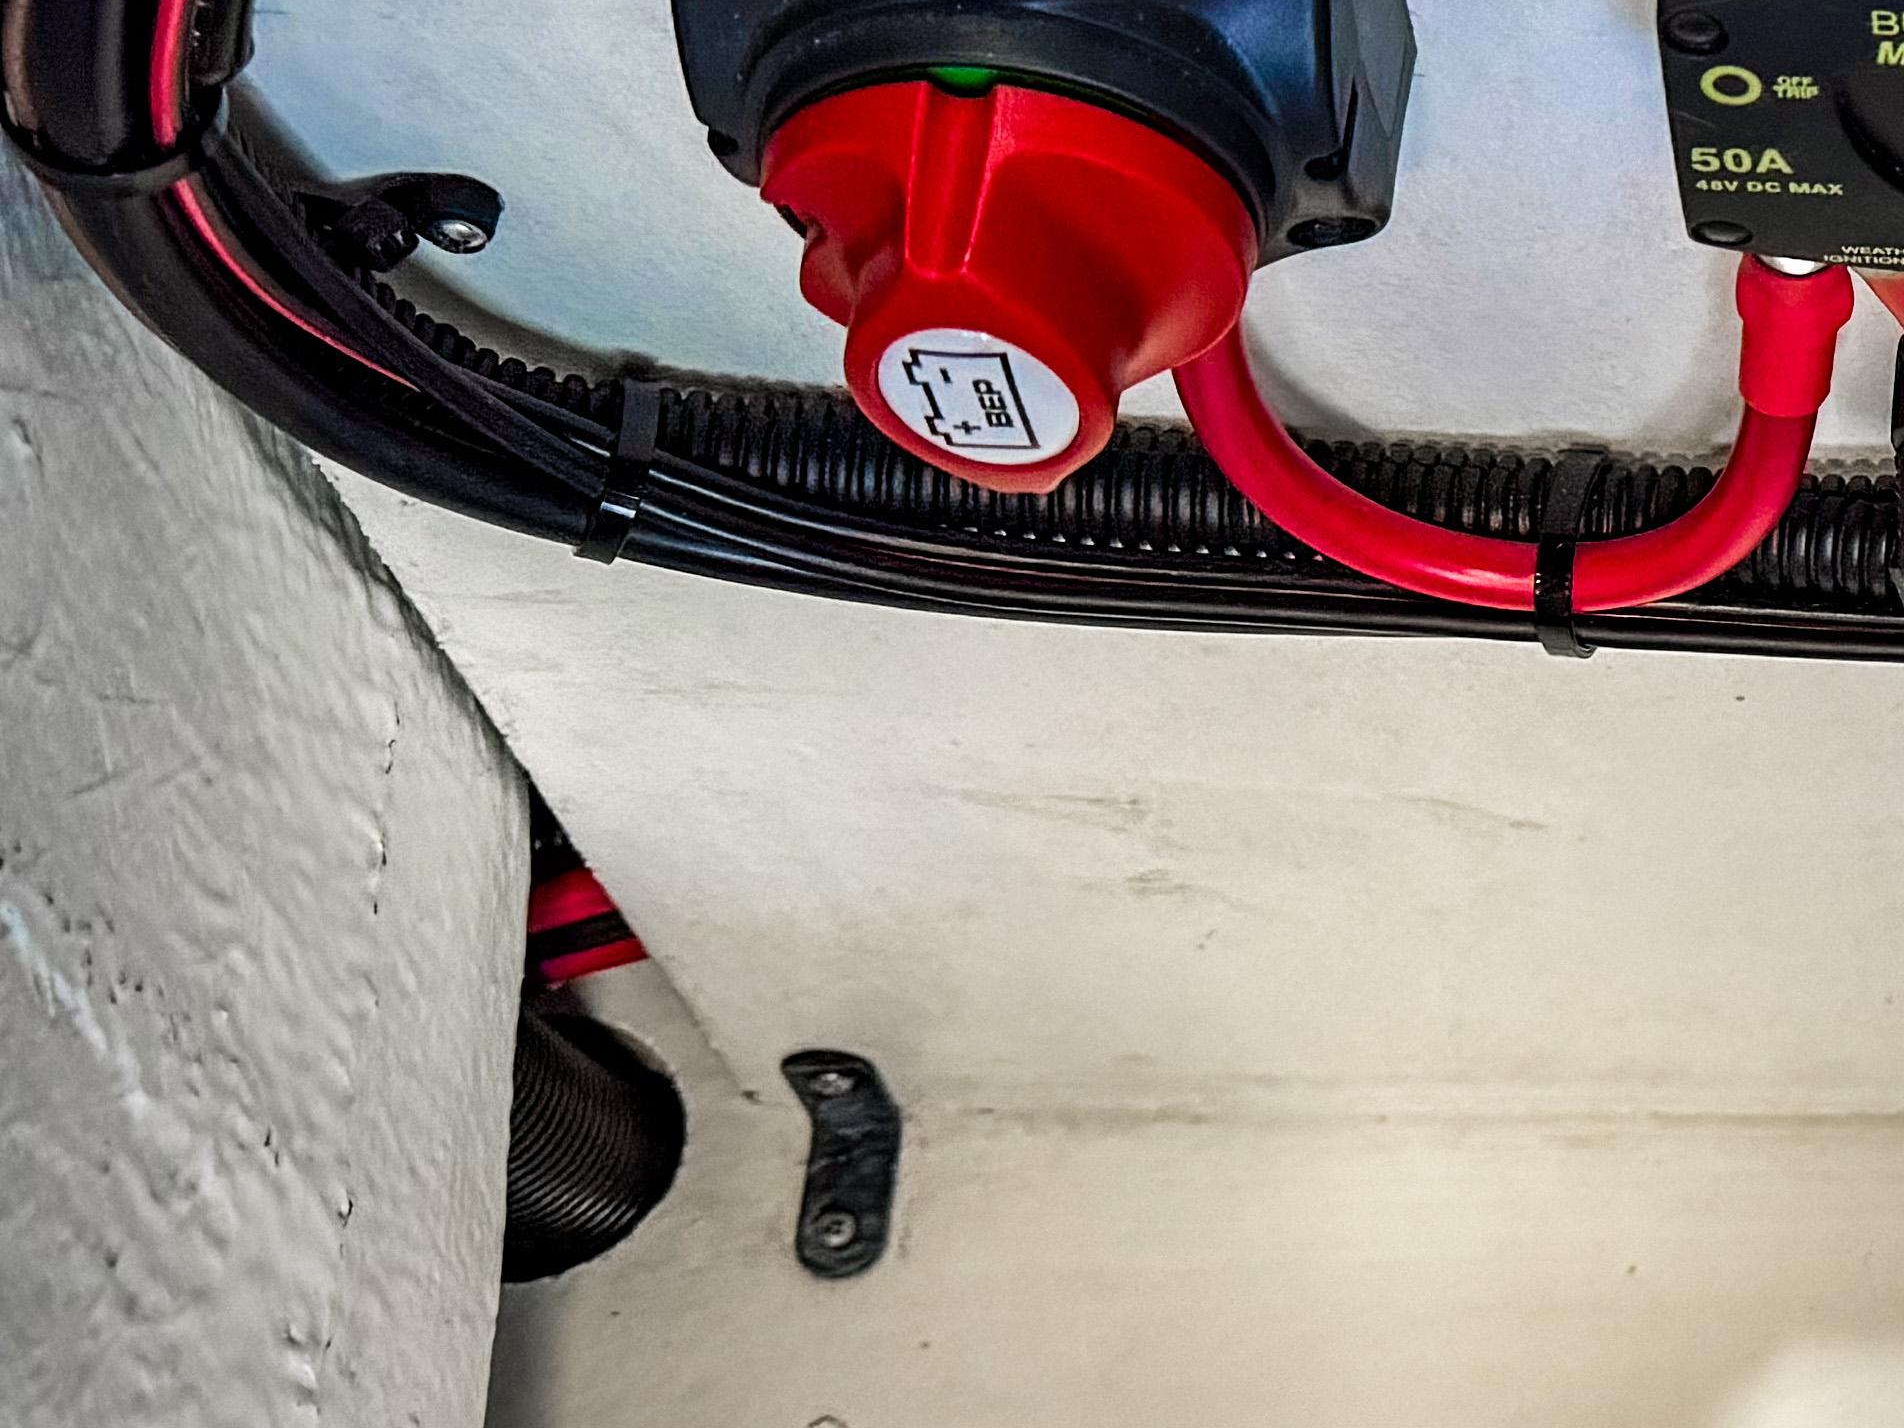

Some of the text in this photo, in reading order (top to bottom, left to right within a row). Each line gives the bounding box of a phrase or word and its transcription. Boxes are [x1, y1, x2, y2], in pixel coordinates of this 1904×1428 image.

[1776, 75, 1814, 87] OFF
[1772, 84, 1820, 100] TRIP
[1690, 147, 1794, 174] 50A
[1696, 179, 1844, 196] 48V DC MAX
[971, 378, 1016, 428] BEP
